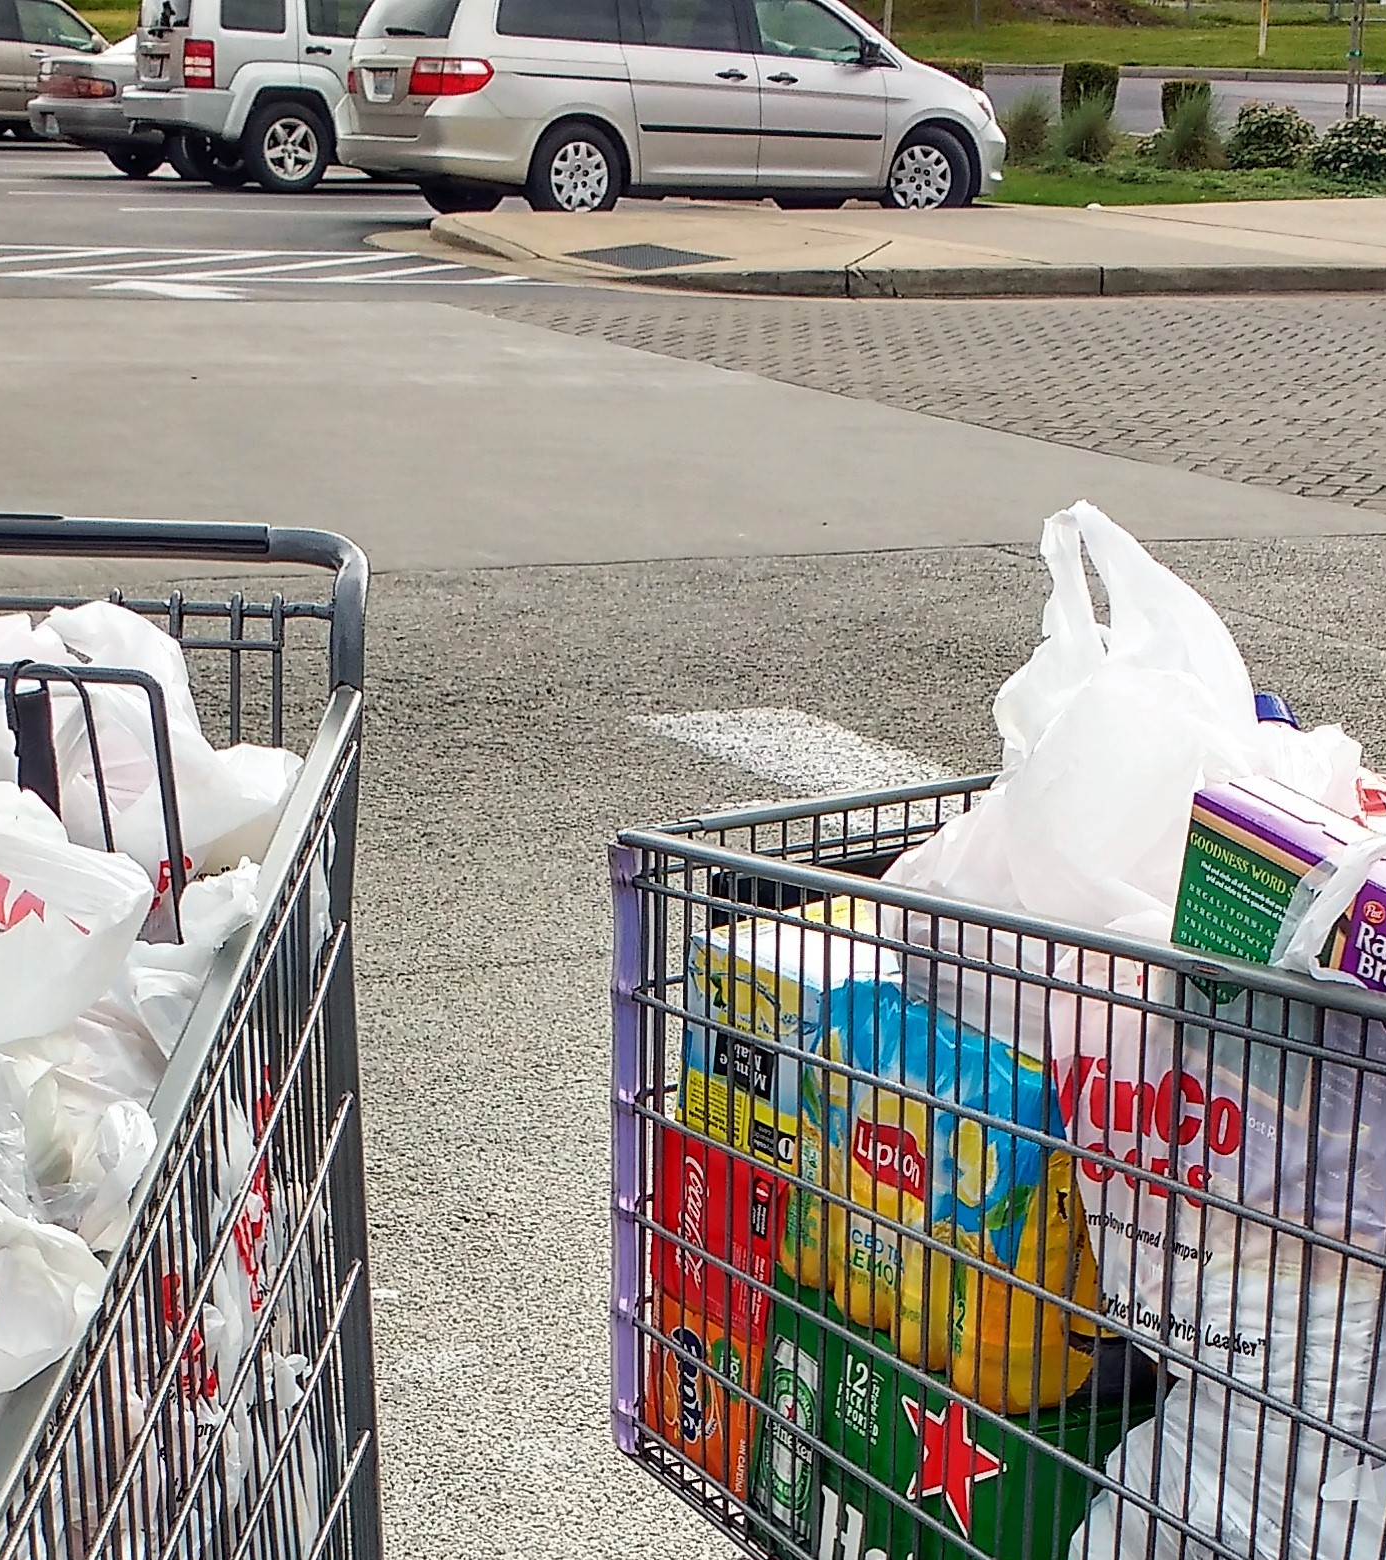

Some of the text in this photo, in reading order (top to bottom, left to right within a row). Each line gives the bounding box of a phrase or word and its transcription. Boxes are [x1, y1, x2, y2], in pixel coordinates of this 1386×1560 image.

[1190, 831, 1287, 895] GOODNESS WORD
[856, 1125, 921, 1189] Lipton
[851, 1229, 885, 1254] CED
[850, 1249, 897, 1286] EMO
